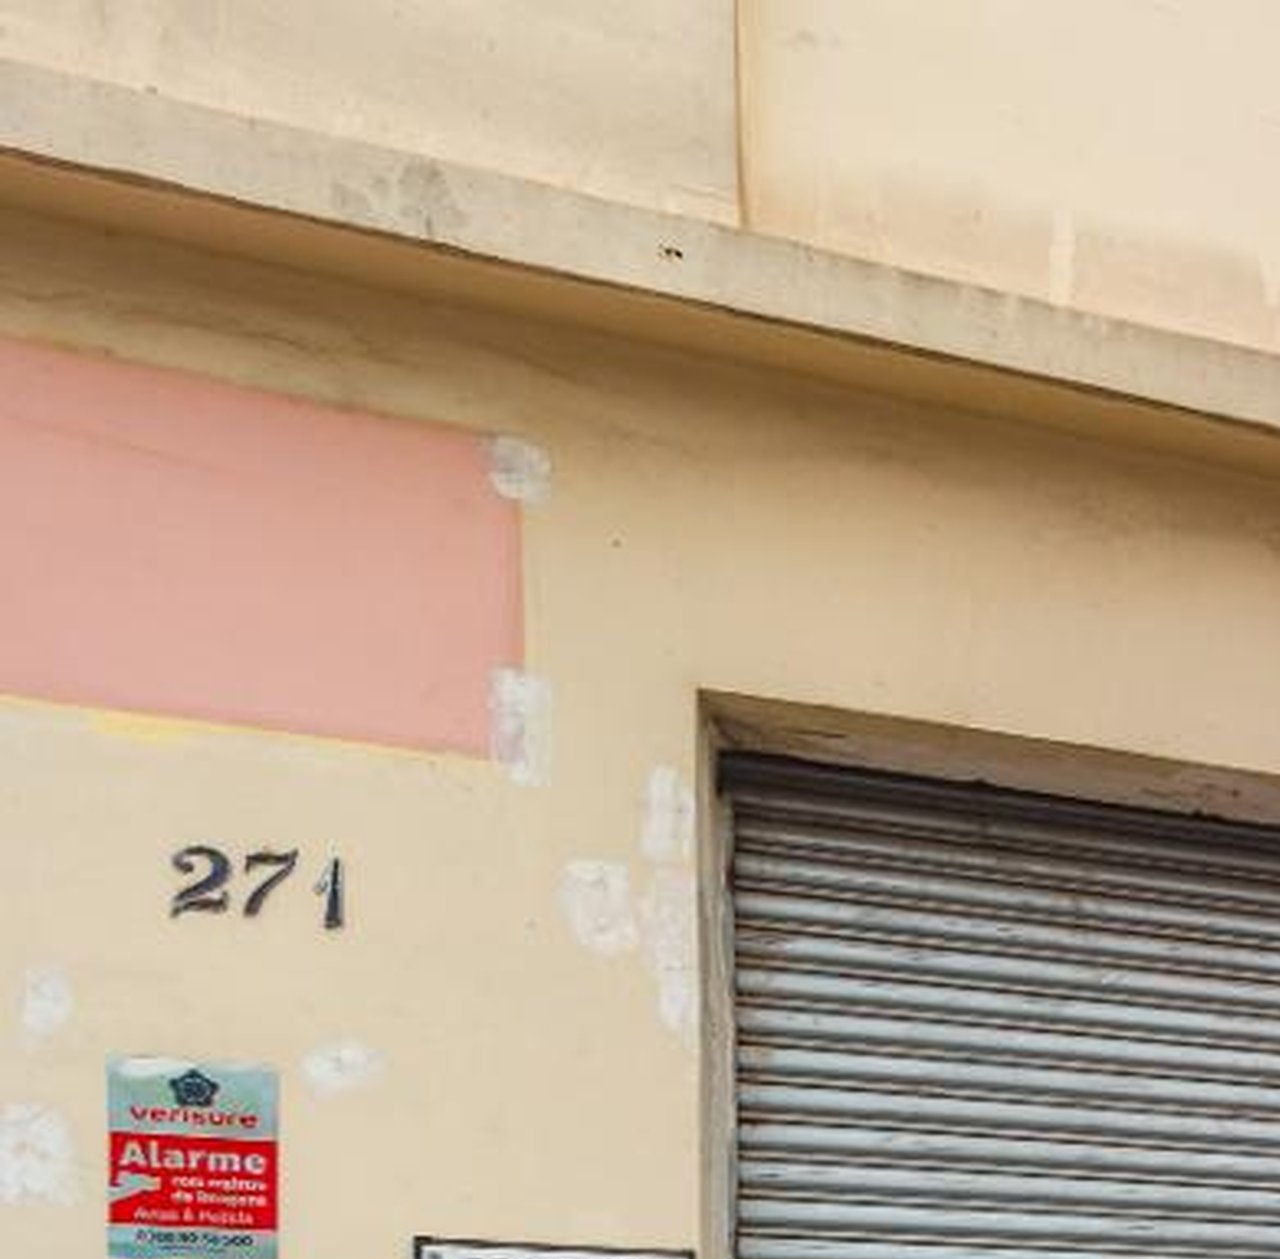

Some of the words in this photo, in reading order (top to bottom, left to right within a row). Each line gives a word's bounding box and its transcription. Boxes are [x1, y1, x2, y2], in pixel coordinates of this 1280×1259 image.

[169, 845, 343, 930] 271
[130, 1104, 258, 1128] verisure
[119, 1141, 267, 1174] Alarme
